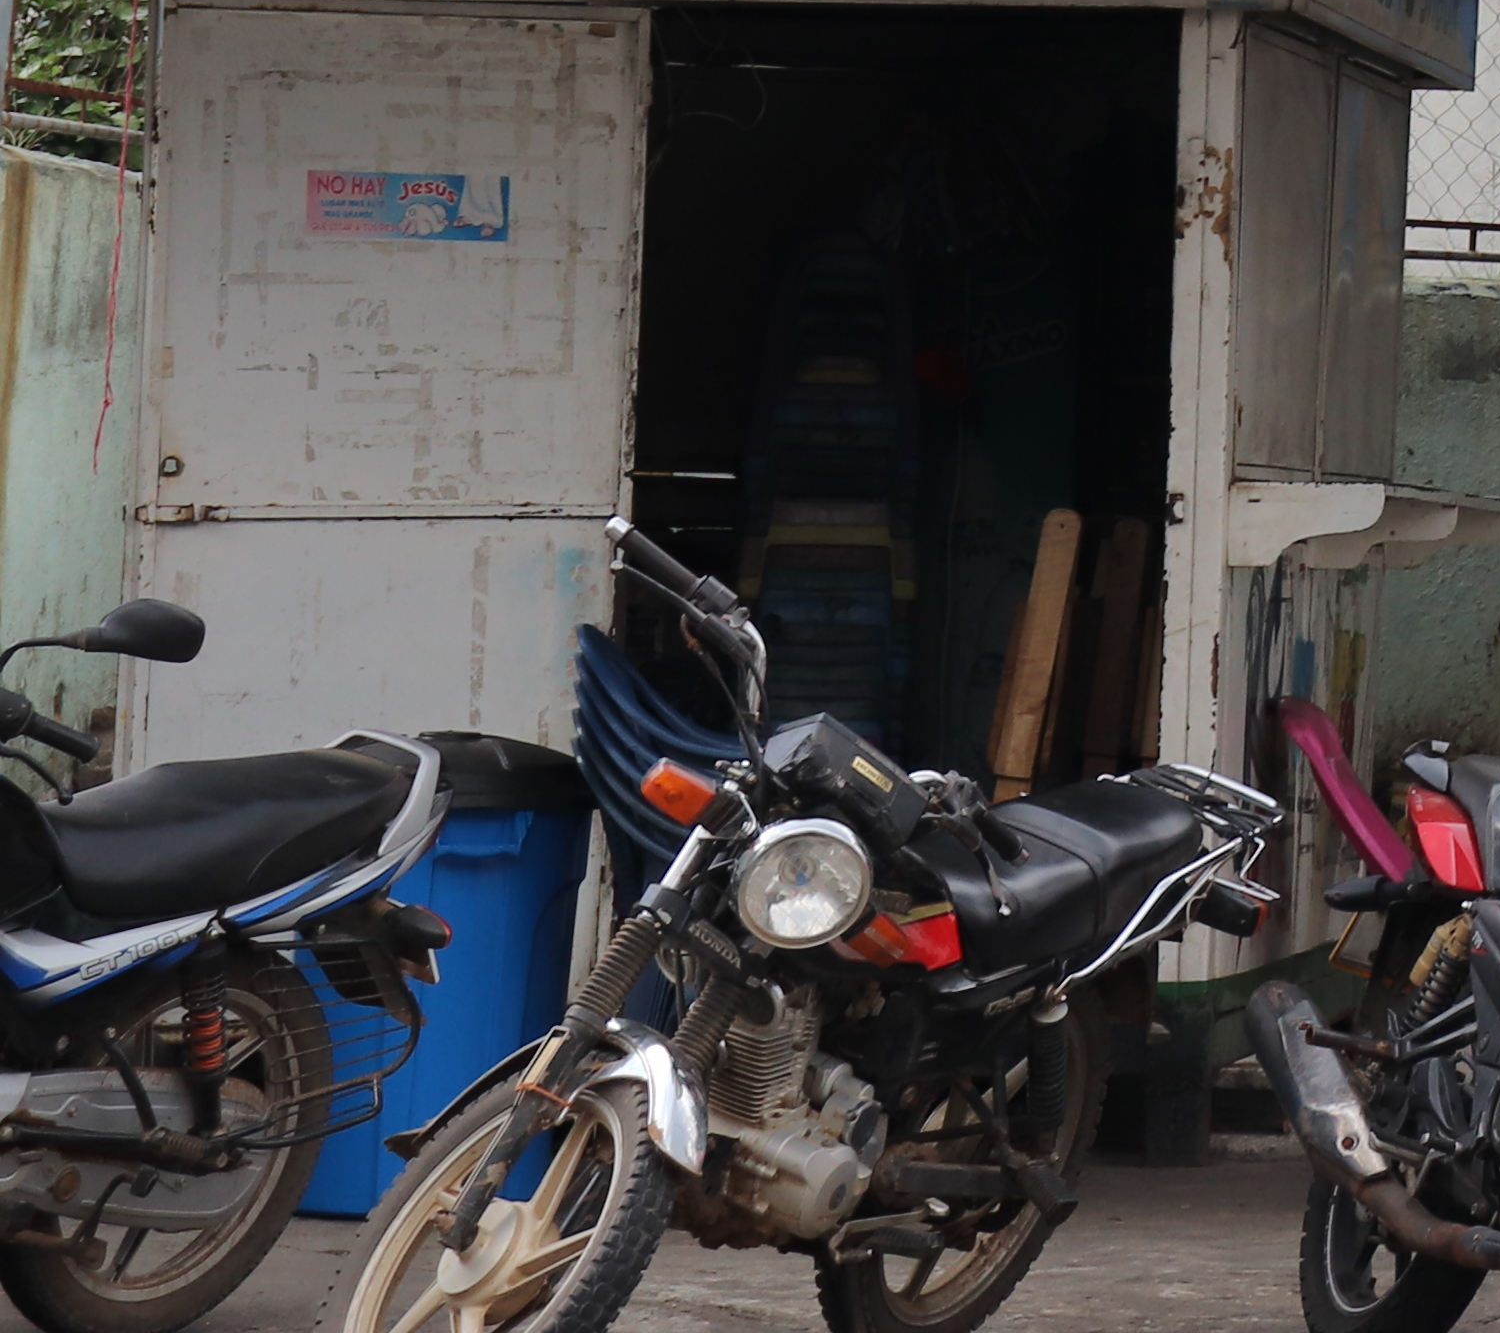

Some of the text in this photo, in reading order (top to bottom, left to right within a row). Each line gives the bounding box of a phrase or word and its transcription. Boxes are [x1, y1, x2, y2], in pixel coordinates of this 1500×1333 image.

[317, 175, 386, 196] NO HAY
[688, 923, 741, 970] HONDA
